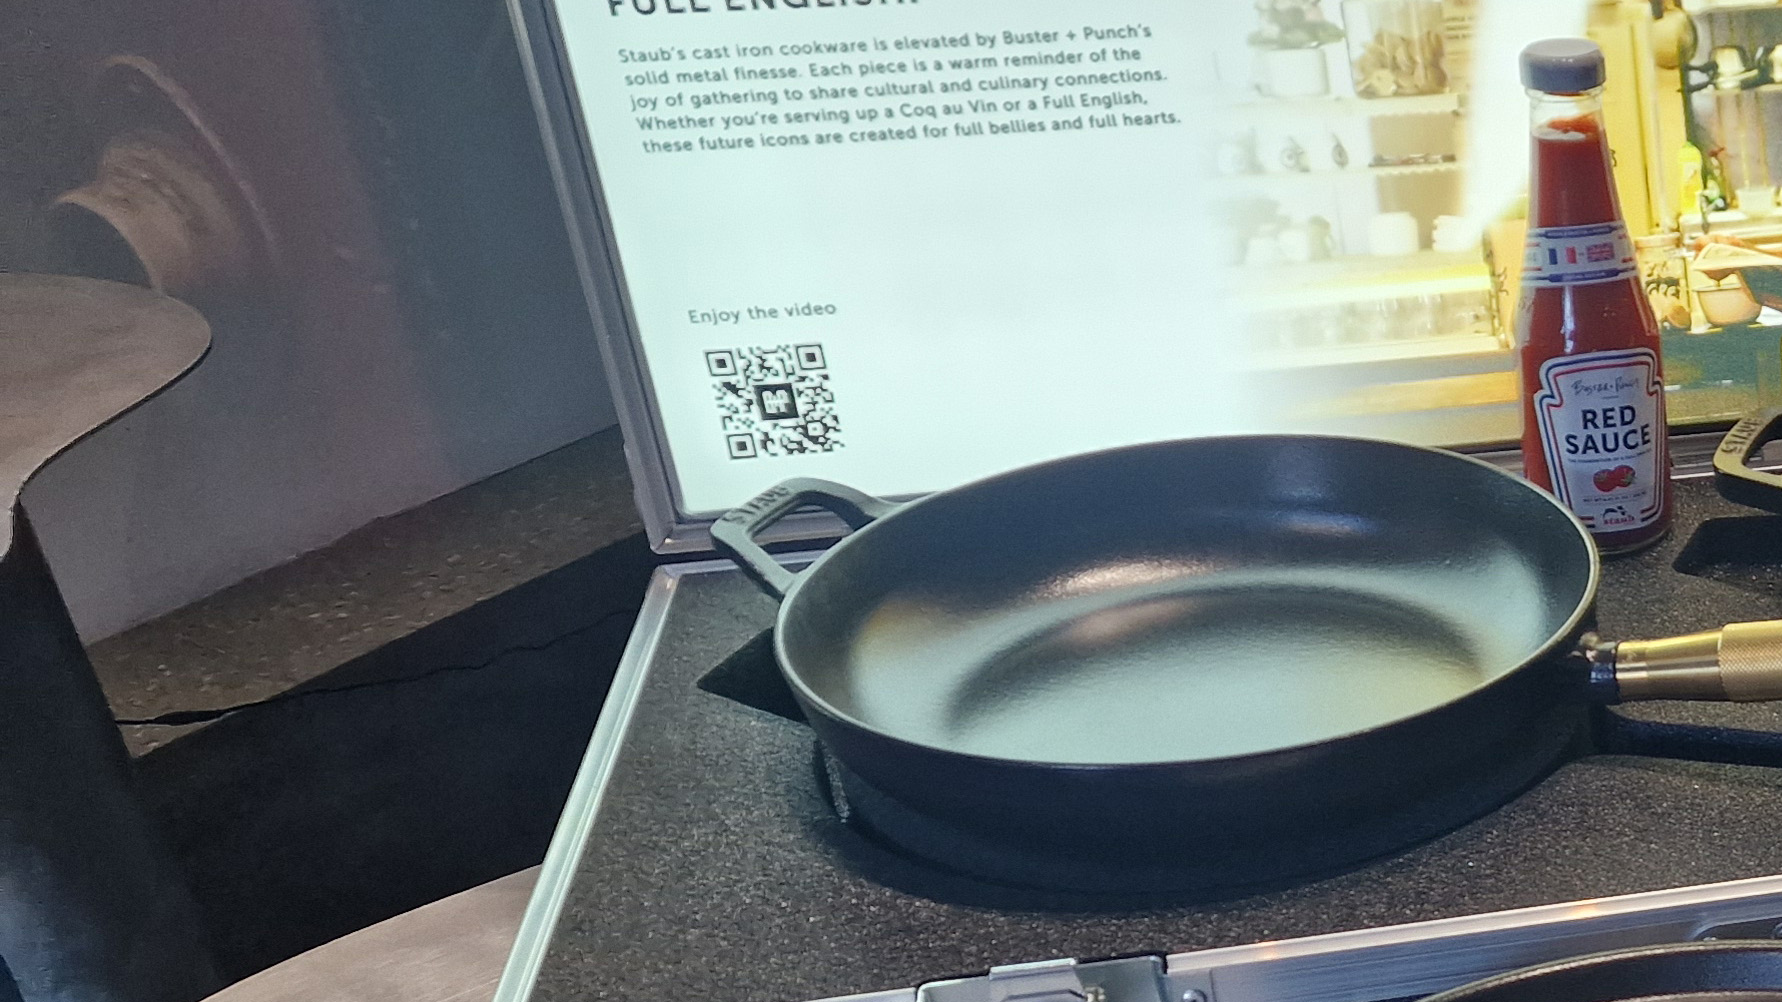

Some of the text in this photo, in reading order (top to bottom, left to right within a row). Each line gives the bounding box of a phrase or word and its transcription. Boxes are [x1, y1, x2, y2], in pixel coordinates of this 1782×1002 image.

[618, 24, 1152, 63] Staub's cast iron cookware is elevated by Buster + Punch's
[625, 48, 1141, 86] solid metal finesse. Each piece is a warm reminder of the
[630, 69, 1167, 112] joy of gathering to share cultural and culinary connections.
[636, 91, 1148, 130] Whether you're serving up a Coq au Vin or a Full English,
[642, 112, 1181, 153] these future icons are created for full bellies and full hearts.
[688, 302, 837, 325] Enjoy the video
[1582, 405, 1636, 430] RED
[1565, 423, 1651, 455] SAUCE
